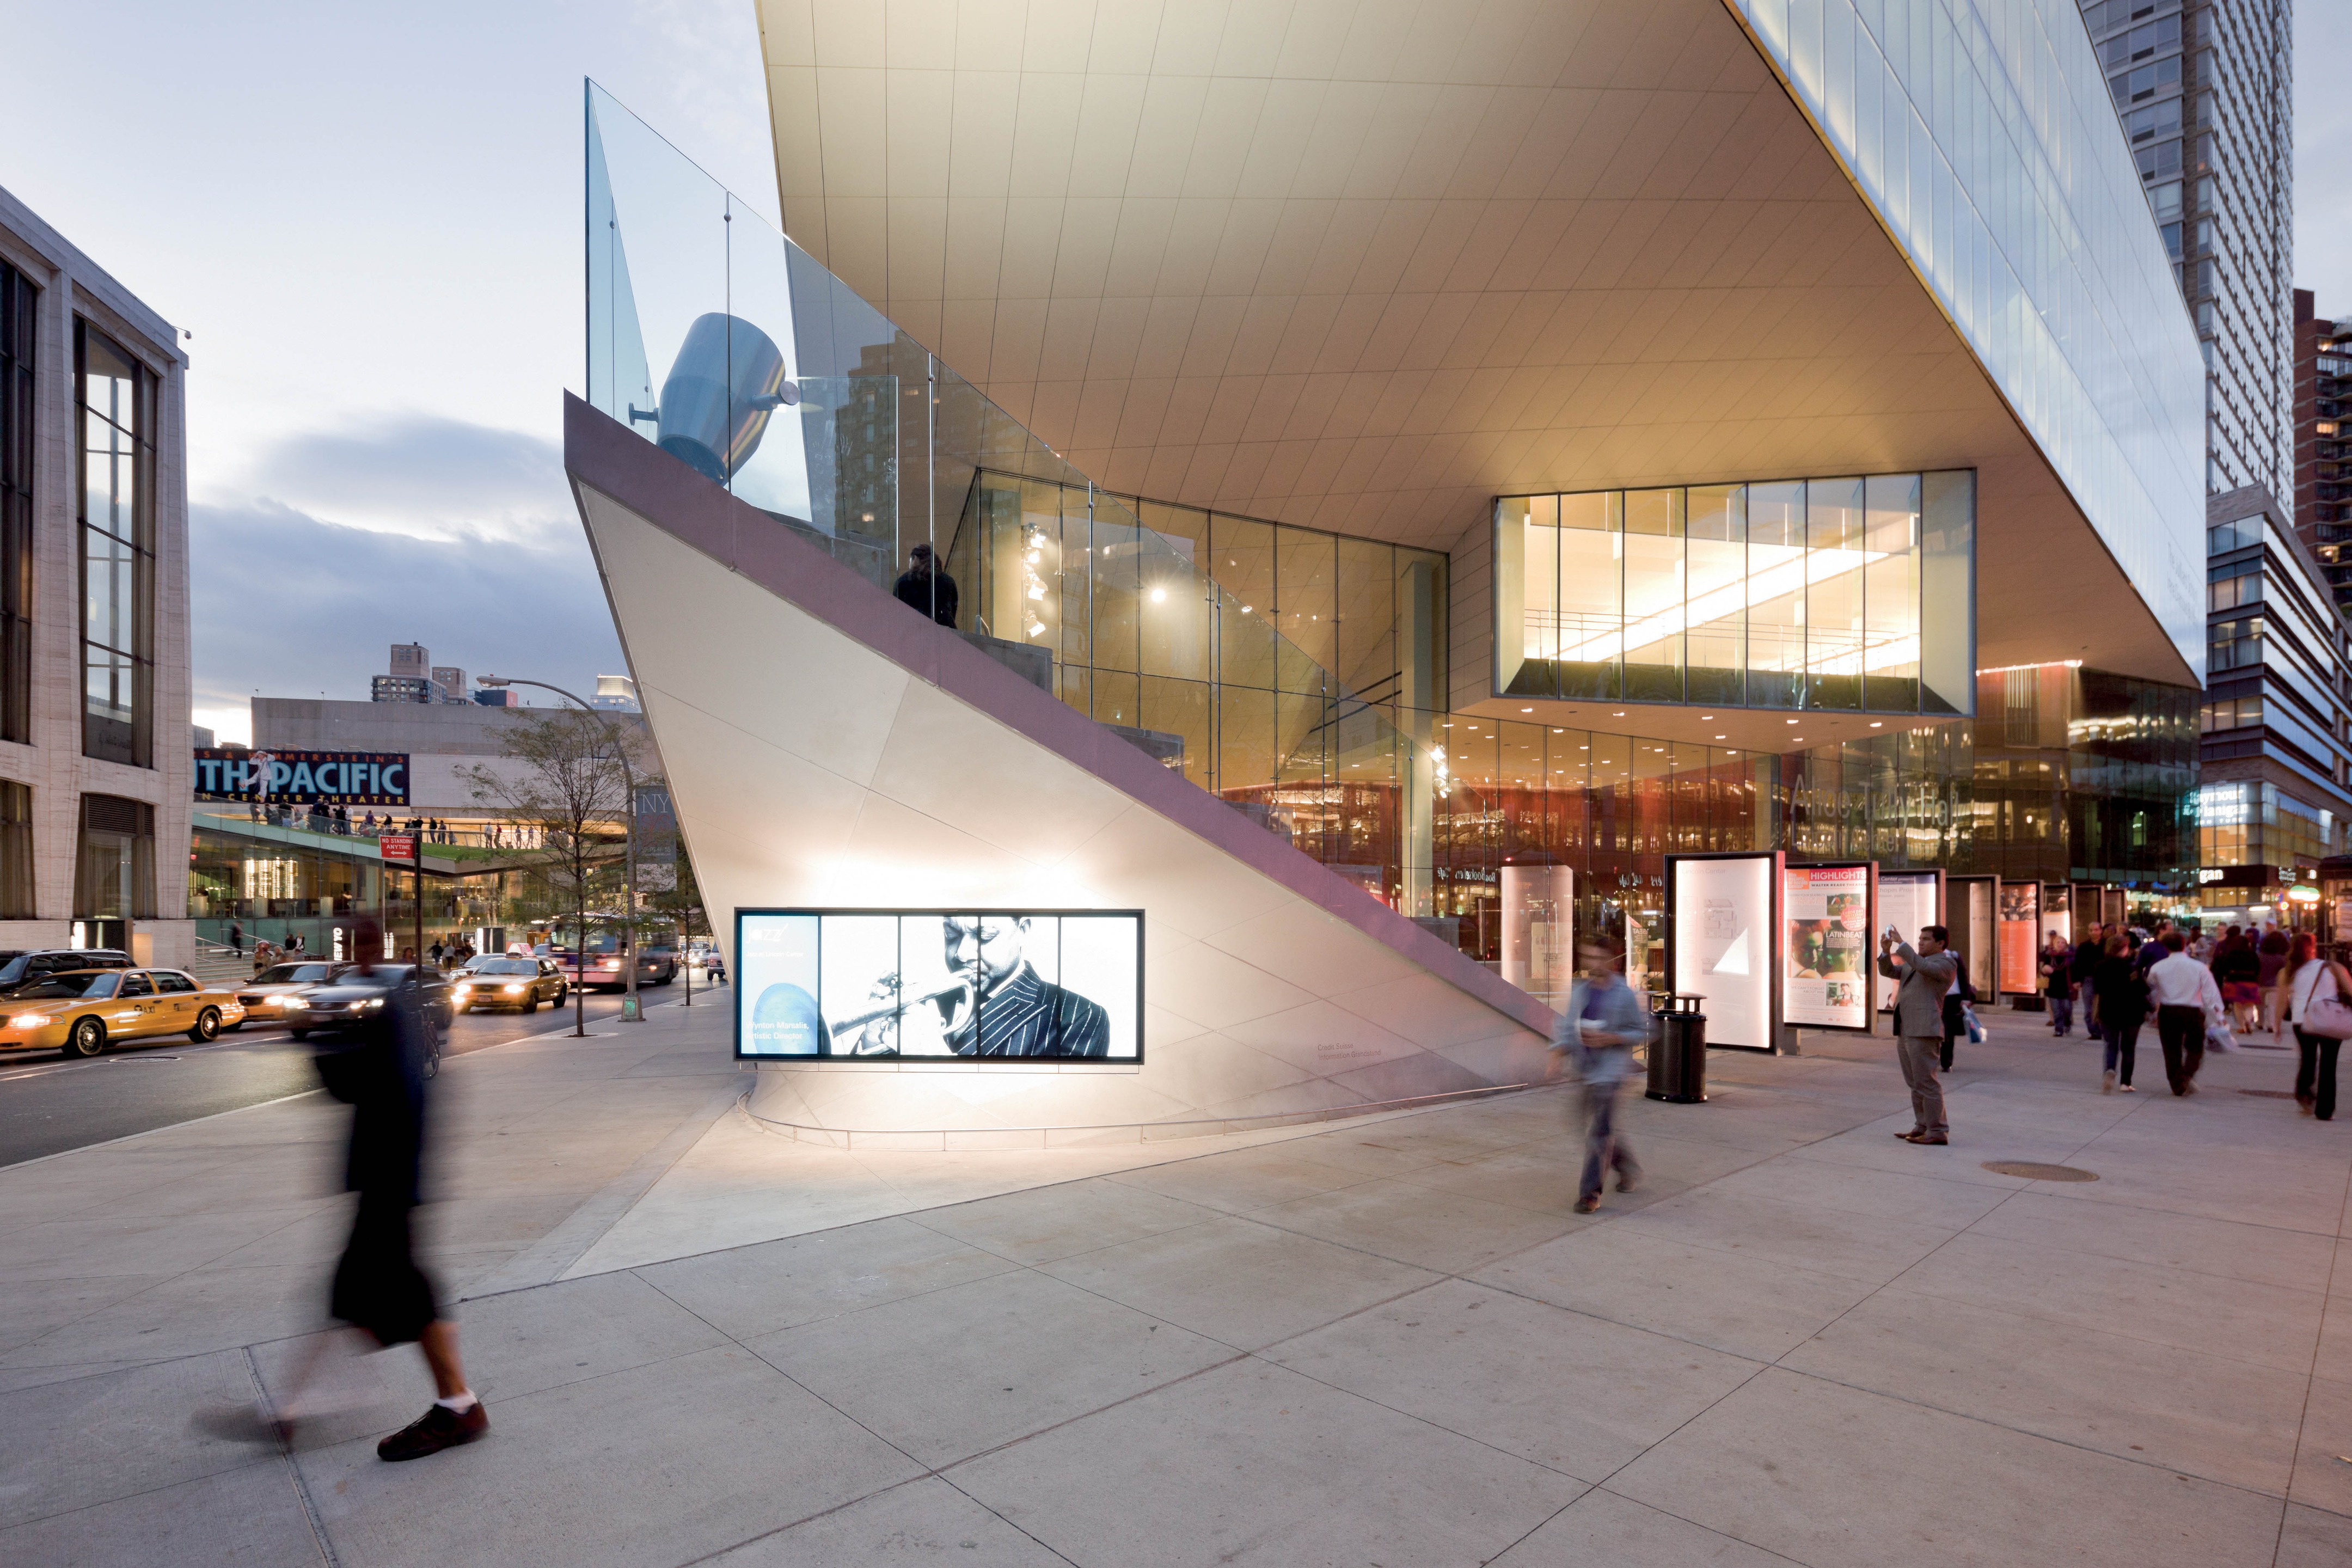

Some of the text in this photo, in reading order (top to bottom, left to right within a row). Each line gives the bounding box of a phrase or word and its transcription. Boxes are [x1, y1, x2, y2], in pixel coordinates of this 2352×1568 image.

[248, 752, 404, 763] HMMERSTEIN'S
[194, 759, 403, 795] TH PACIFIC
[228, 793, 303, 803] CENTER
[318, 795, 405, 804] THEATER
[641, 794, 670, 813] NY
[1920, 787, 1958, 826] Hall
[1810, 871, 1867, 880] HIGHLIGHTS
[2200, 869, 2224, 884] gan
[745, 1021, 810, 1030] Wynton Marsalis,
[1319, 1049, 1381, 1061] Information Grandstand
